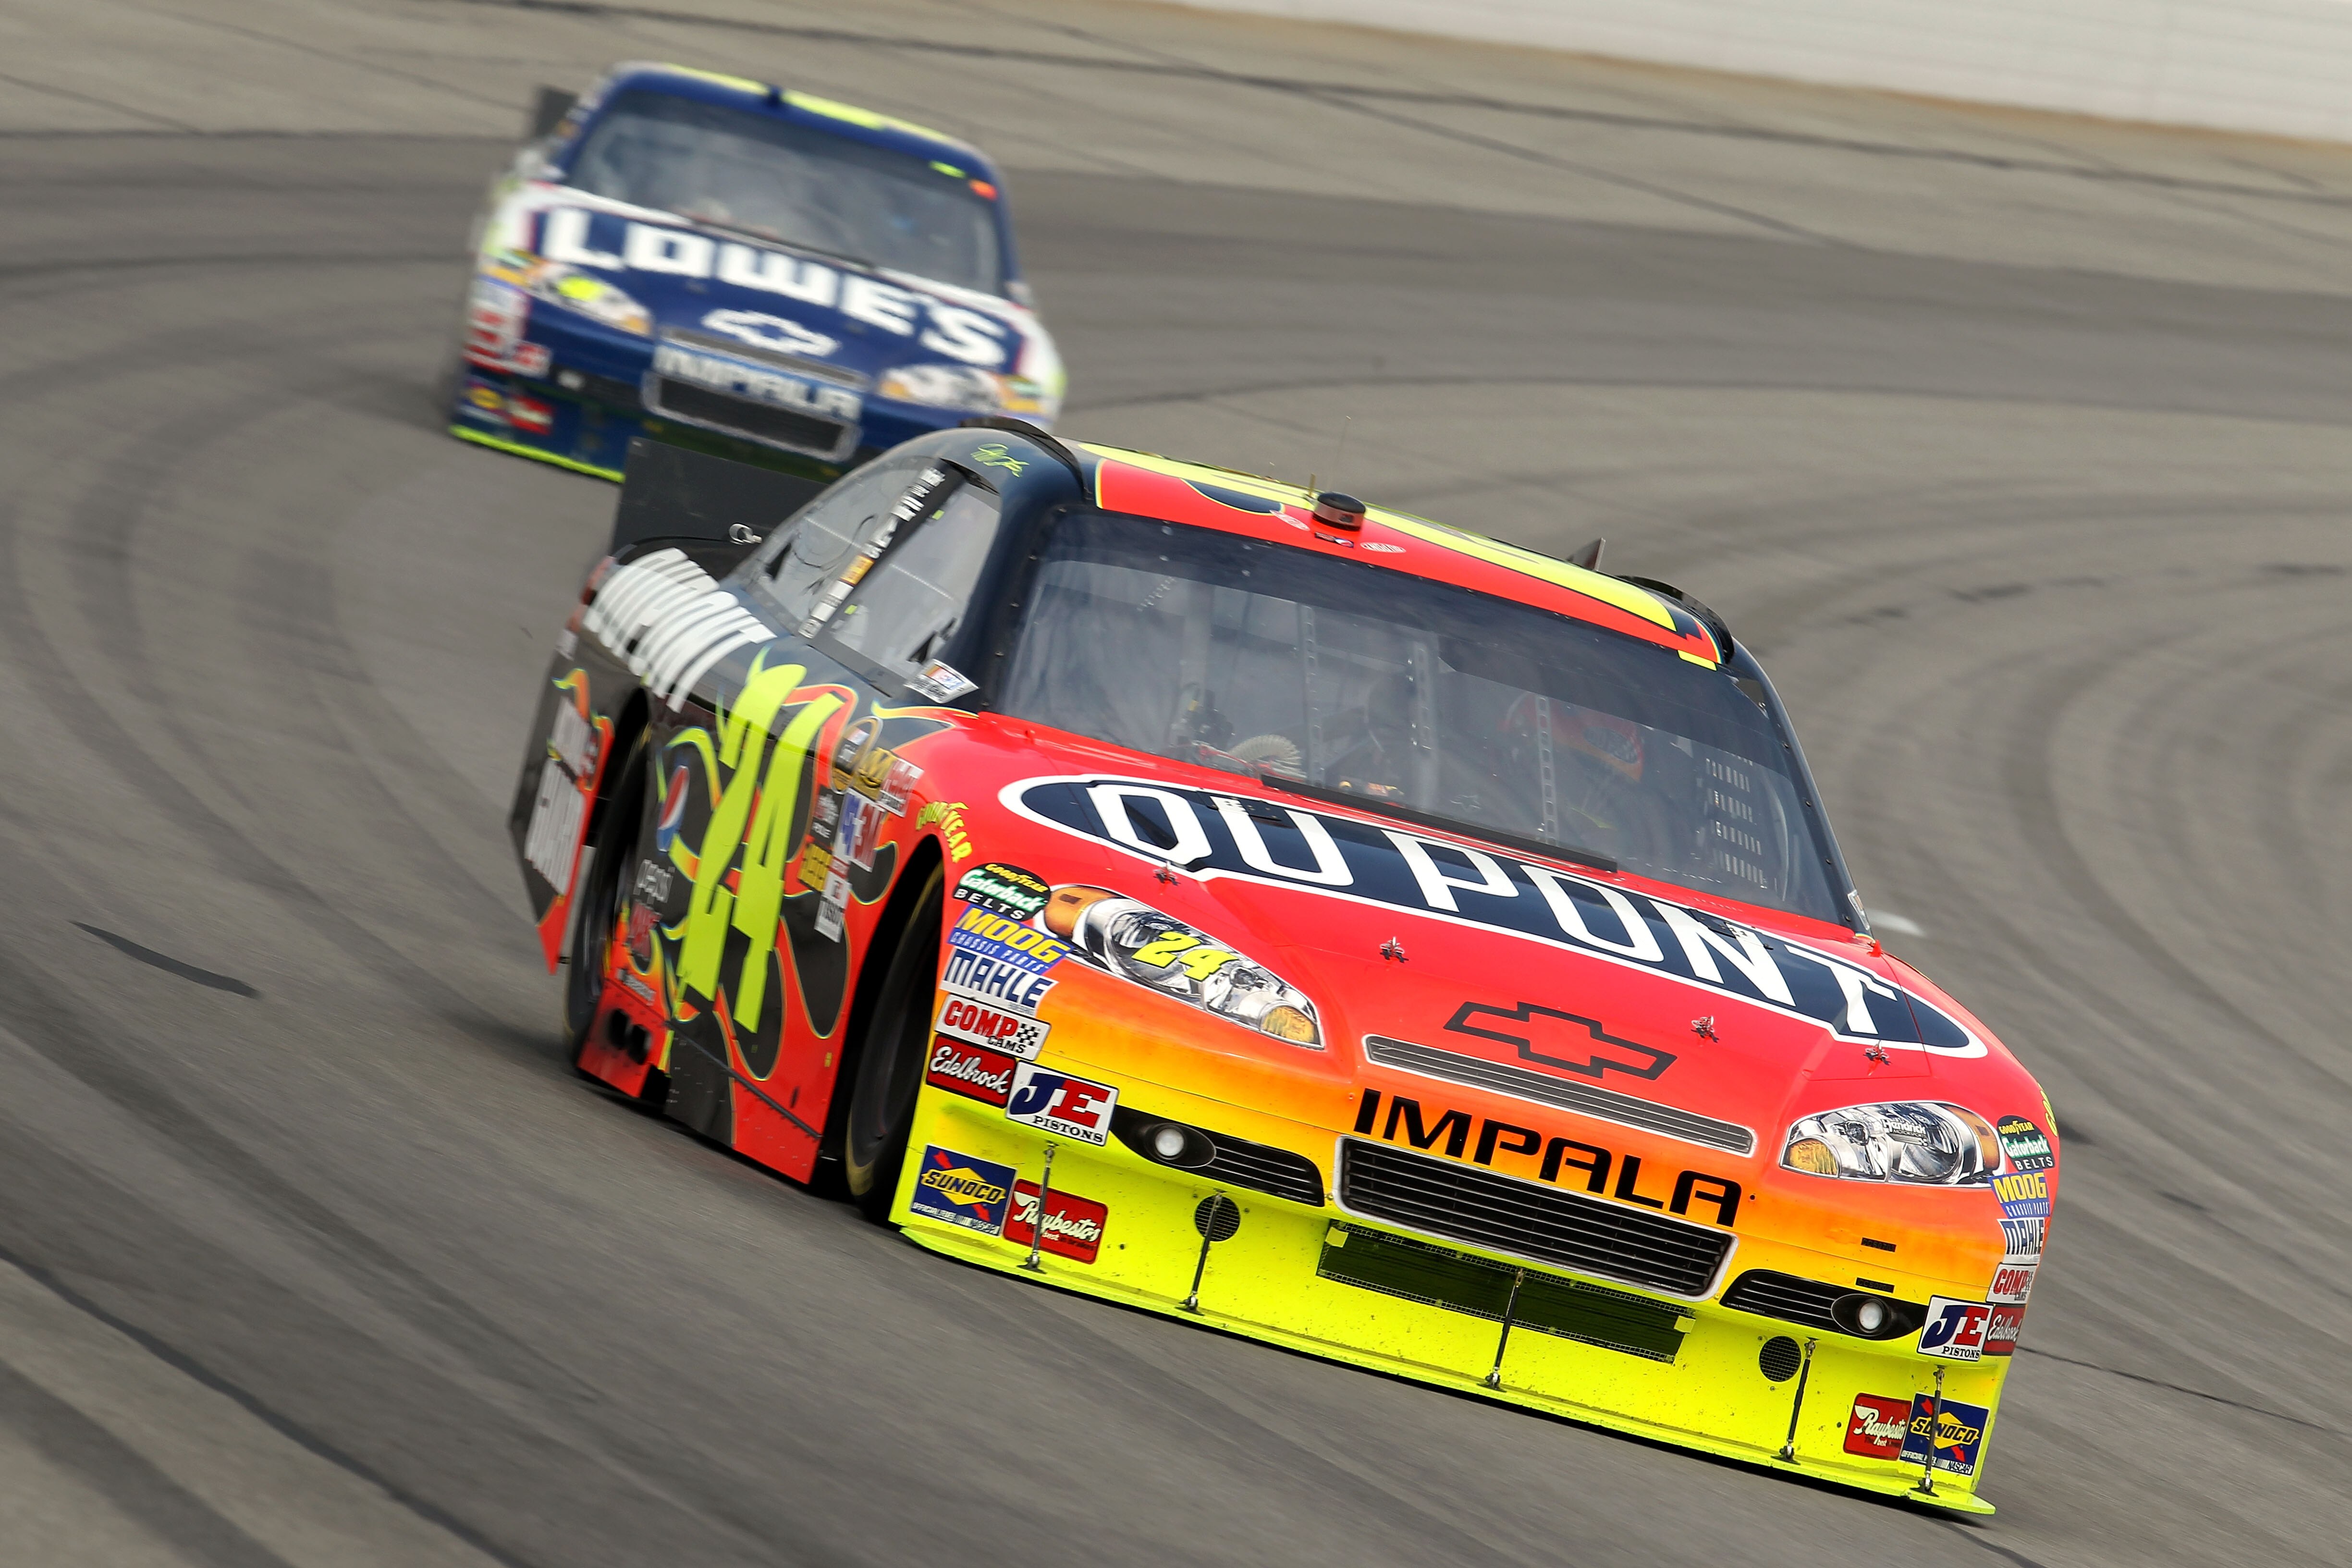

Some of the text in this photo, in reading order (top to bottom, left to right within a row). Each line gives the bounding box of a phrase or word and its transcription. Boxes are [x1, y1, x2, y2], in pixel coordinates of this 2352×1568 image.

[652, 345, 861, 419] IMPALA
[675, 663, 844, 1034] 24
[960, 869, 1043, 912] Gatorback
[985, 864, 1048, 893] GOODYEAR
[954, 889, 1026, 920] BELTS
[955, 907, 1071, 964] MOOG
[950, 932, 1044, 972] CHASSIS PARTS
[1132, 931, 1237, 981] 24
[944, 949, 1053, 1008] MAHLE
[944, 1000, 1018, 1039] COMP
[987, 1035, 1026, 1054] CAMS
[930, 1046, 1011, 1094] Edelbrock
[1010, 1072, 1111, 1128] JE
[1032, 1115, 1103, 1143] PISTONS
[1881, 1119, 1926, 1134] Hendrick
[1998, 1121, 2034, 1135] GOODYEAR
[1354, 1088, 1742, 1227] IMPALA
[2001, 1134, 2049, 1158] Gatorback
[2016, 1156, 2053, 1171] BELTS
[926, 1171, 1002, 1202] SUNOCO
[1993, 1173, 2046, 1204] MOOG
[2007, 1205, 2032, 1217] CHASSIS
[1994, 1269, 2029, 1295] COMP
[1921, 1305, 1988, 1349] JE
[1942, 1345, 1980, 1359] PISTONS
